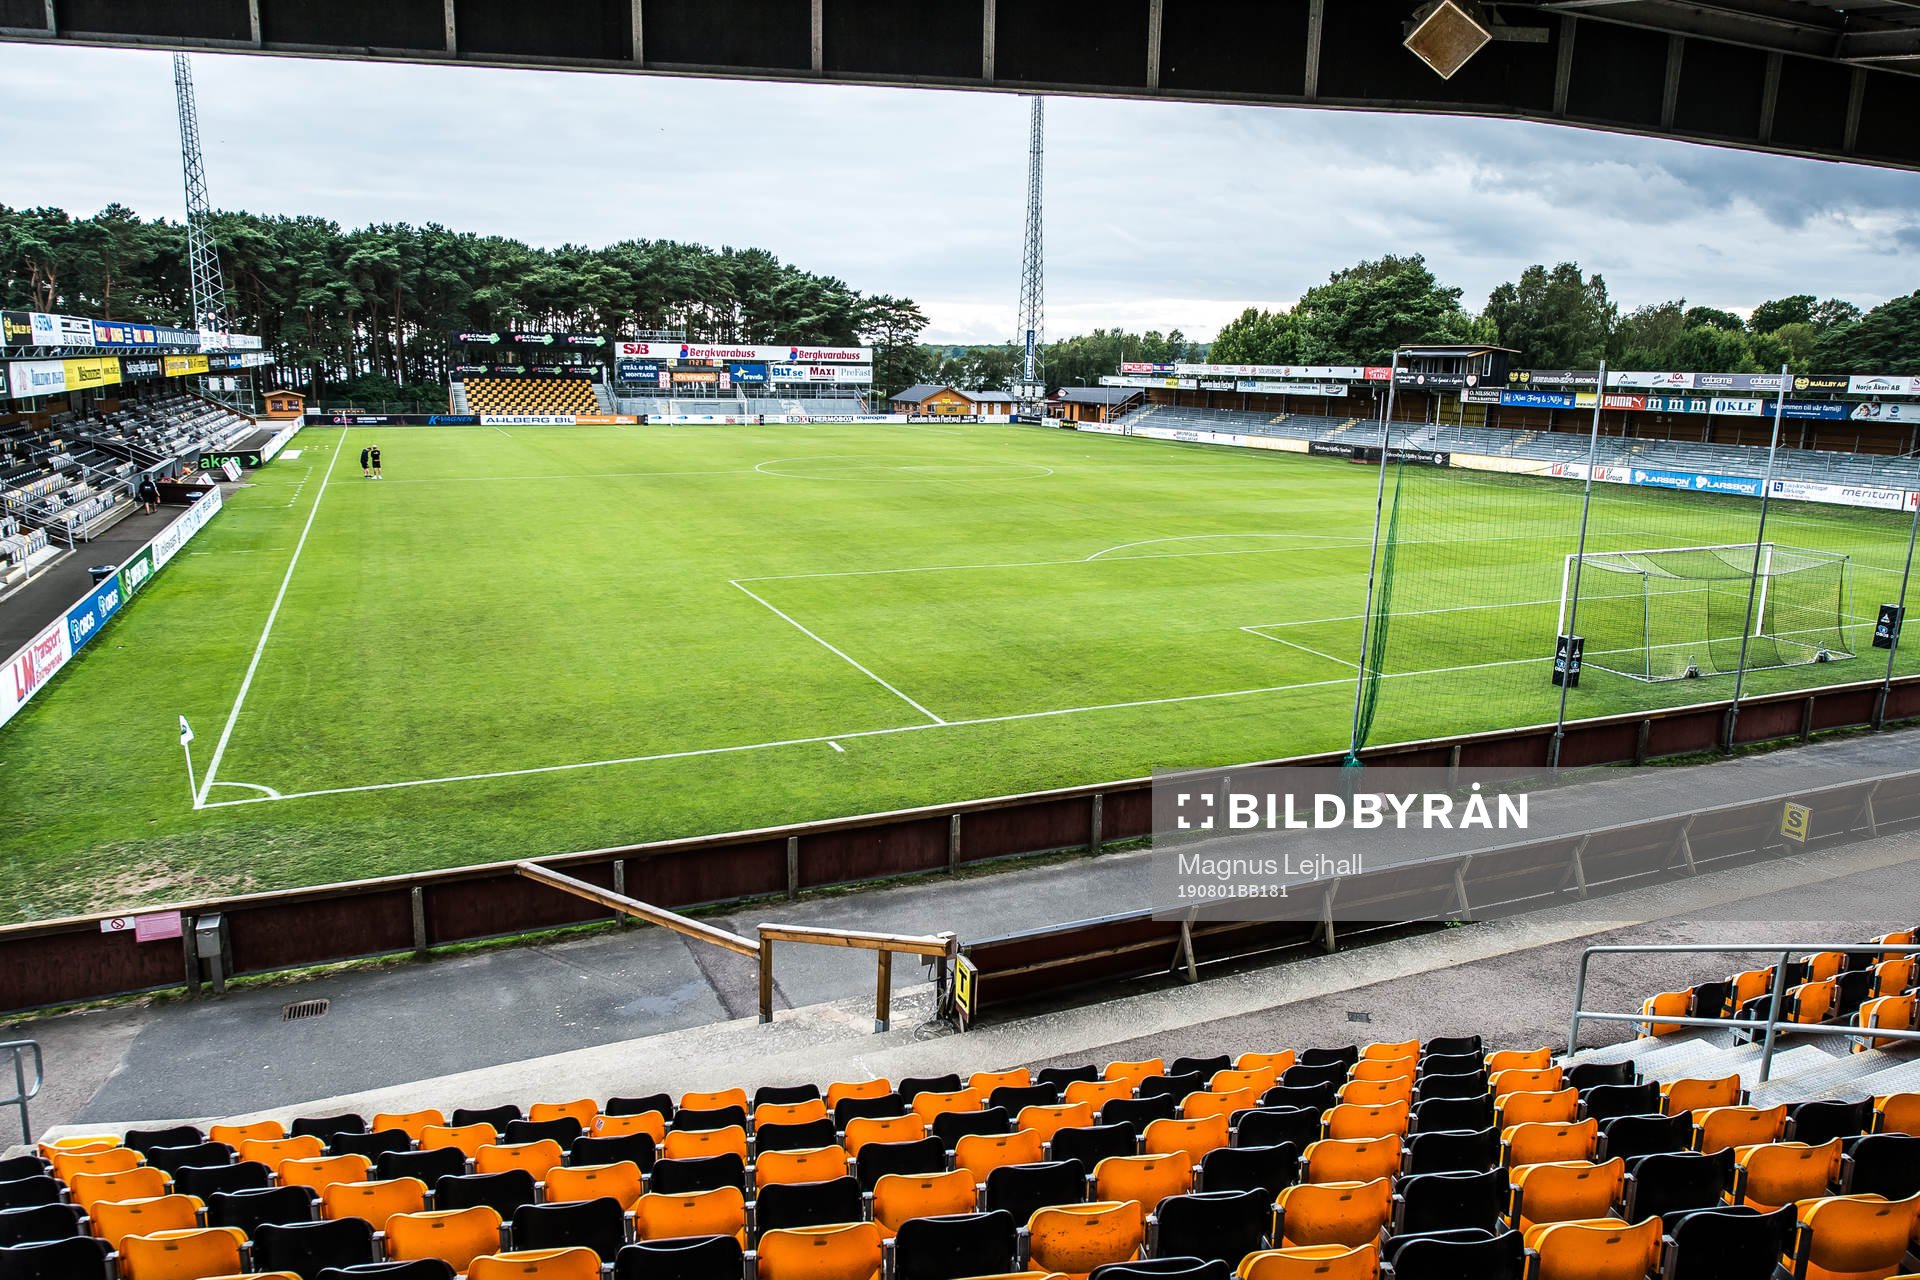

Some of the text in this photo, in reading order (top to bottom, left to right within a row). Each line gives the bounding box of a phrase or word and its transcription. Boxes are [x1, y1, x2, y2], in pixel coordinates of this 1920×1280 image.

[690, 348, 755, 360] Bergkvarabuss
[798, 350, 860, 361] Bergkvarabuss
[622, 363, 638, 371] STÅL
[772, 367, 803, 377] BLT.se
[809, 367, 835, 376] MAXI
[841, 368, 871, 377] PreFast
[1873, 383, 1890, 391] Åkeri
[1604, 395, 1632, 407] PUMA
[908, 415, 928, 424] Sweden
[928, 415, 940, 424] Rock
[941, 415, 961, 424] Festival
[1563, 470, 1579, 478] Group
[1606, 474, 1623, 482] Group
[1645, 476, 1689, 486] LARSSON
[1707, 481, 1756, 492] LARSSON
[1842, 489, 1900, 501] meritum
[105, 589, 118, 611] OBOS
[80, 611, 95, 636] OBOS
[14, 649, 36, 702] LM
[1788, 810, 1803, 828] S
[959, 969, 967, 993] T
